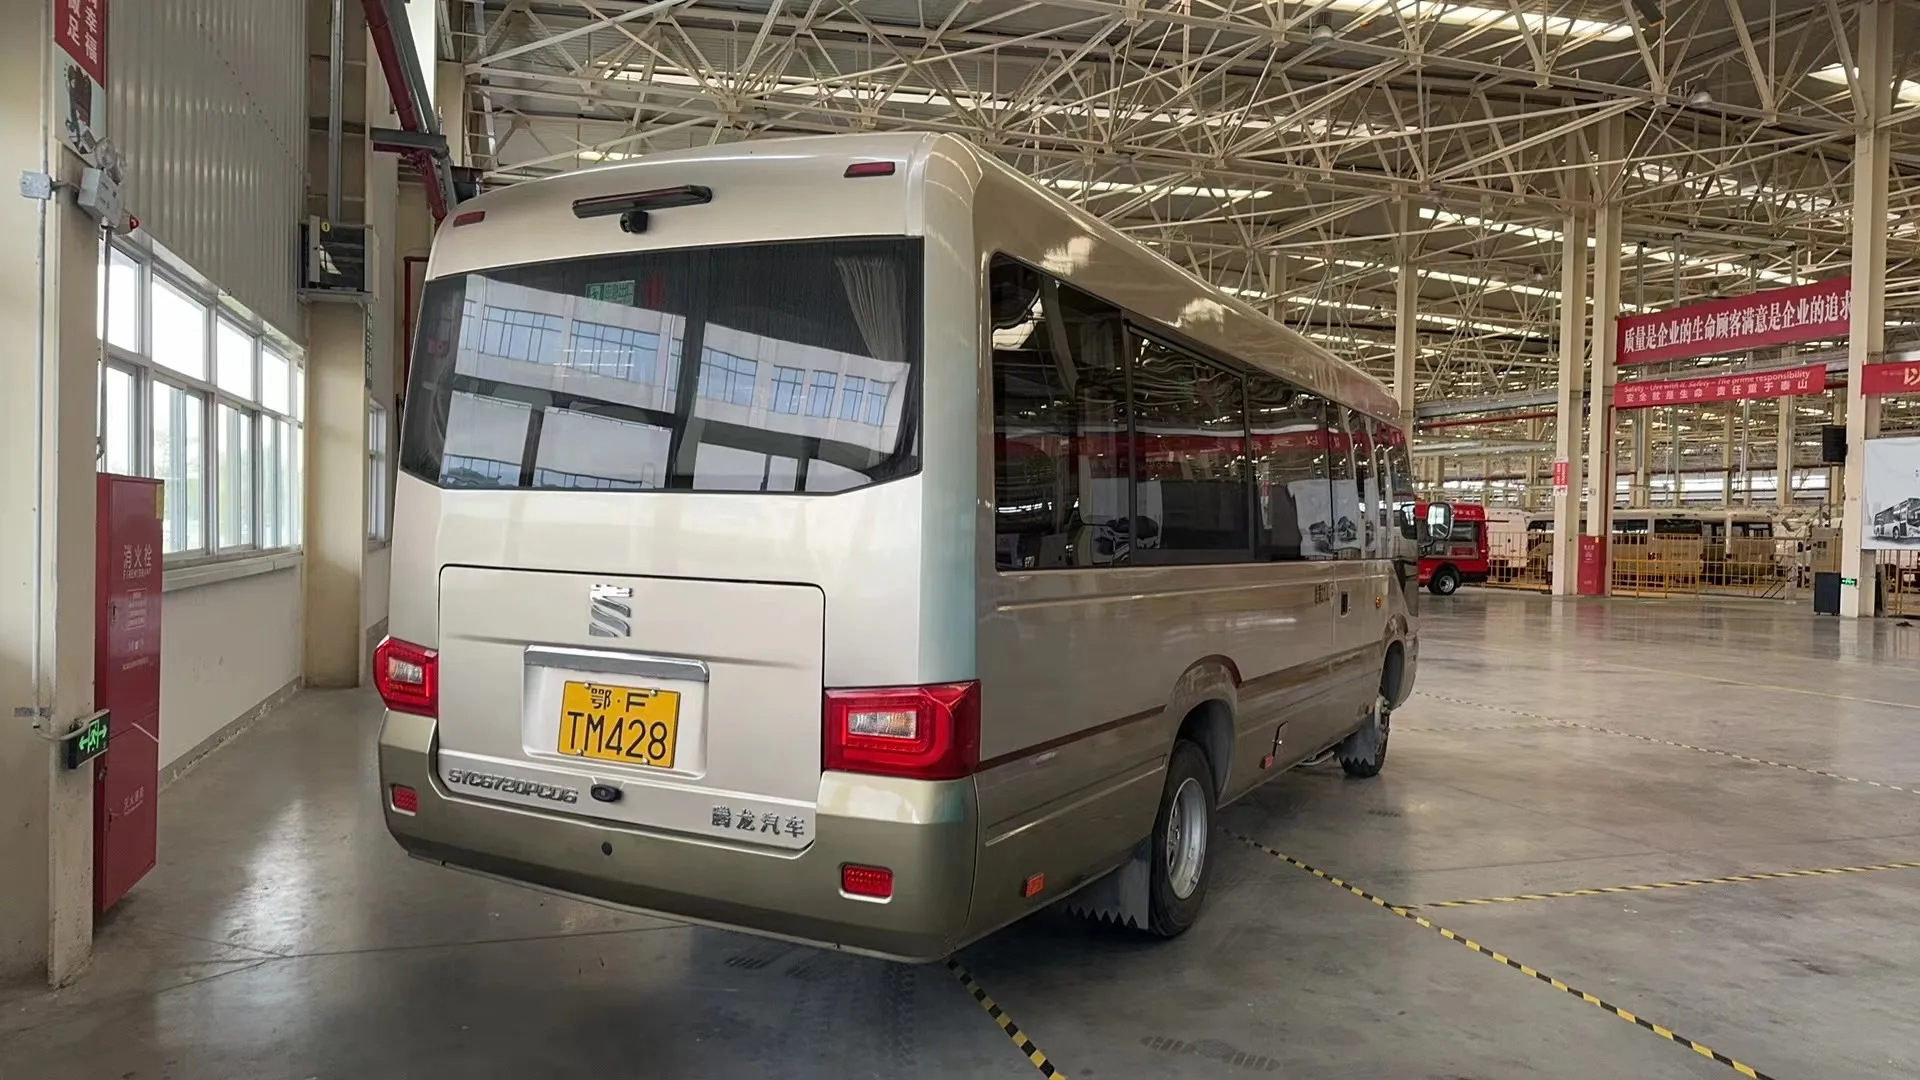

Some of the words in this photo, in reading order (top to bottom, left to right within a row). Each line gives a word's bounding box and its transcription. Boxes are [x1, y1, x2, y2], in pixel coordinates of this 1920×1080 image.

[1623, 290, 1851, 354] 质量是企业的生命顾客满意是企业的追求
[1756, 370, 1811, 382] responsibility
[1626, 388, 1704, 403] 安全就是生命
[1717, 379, 1808, 397] 责任重于泰山
[123, 543, 152, 569] 消火栓
[567, 710, 669, 761] TM428
[711, 805, 805, 838] 腾龙汽车
